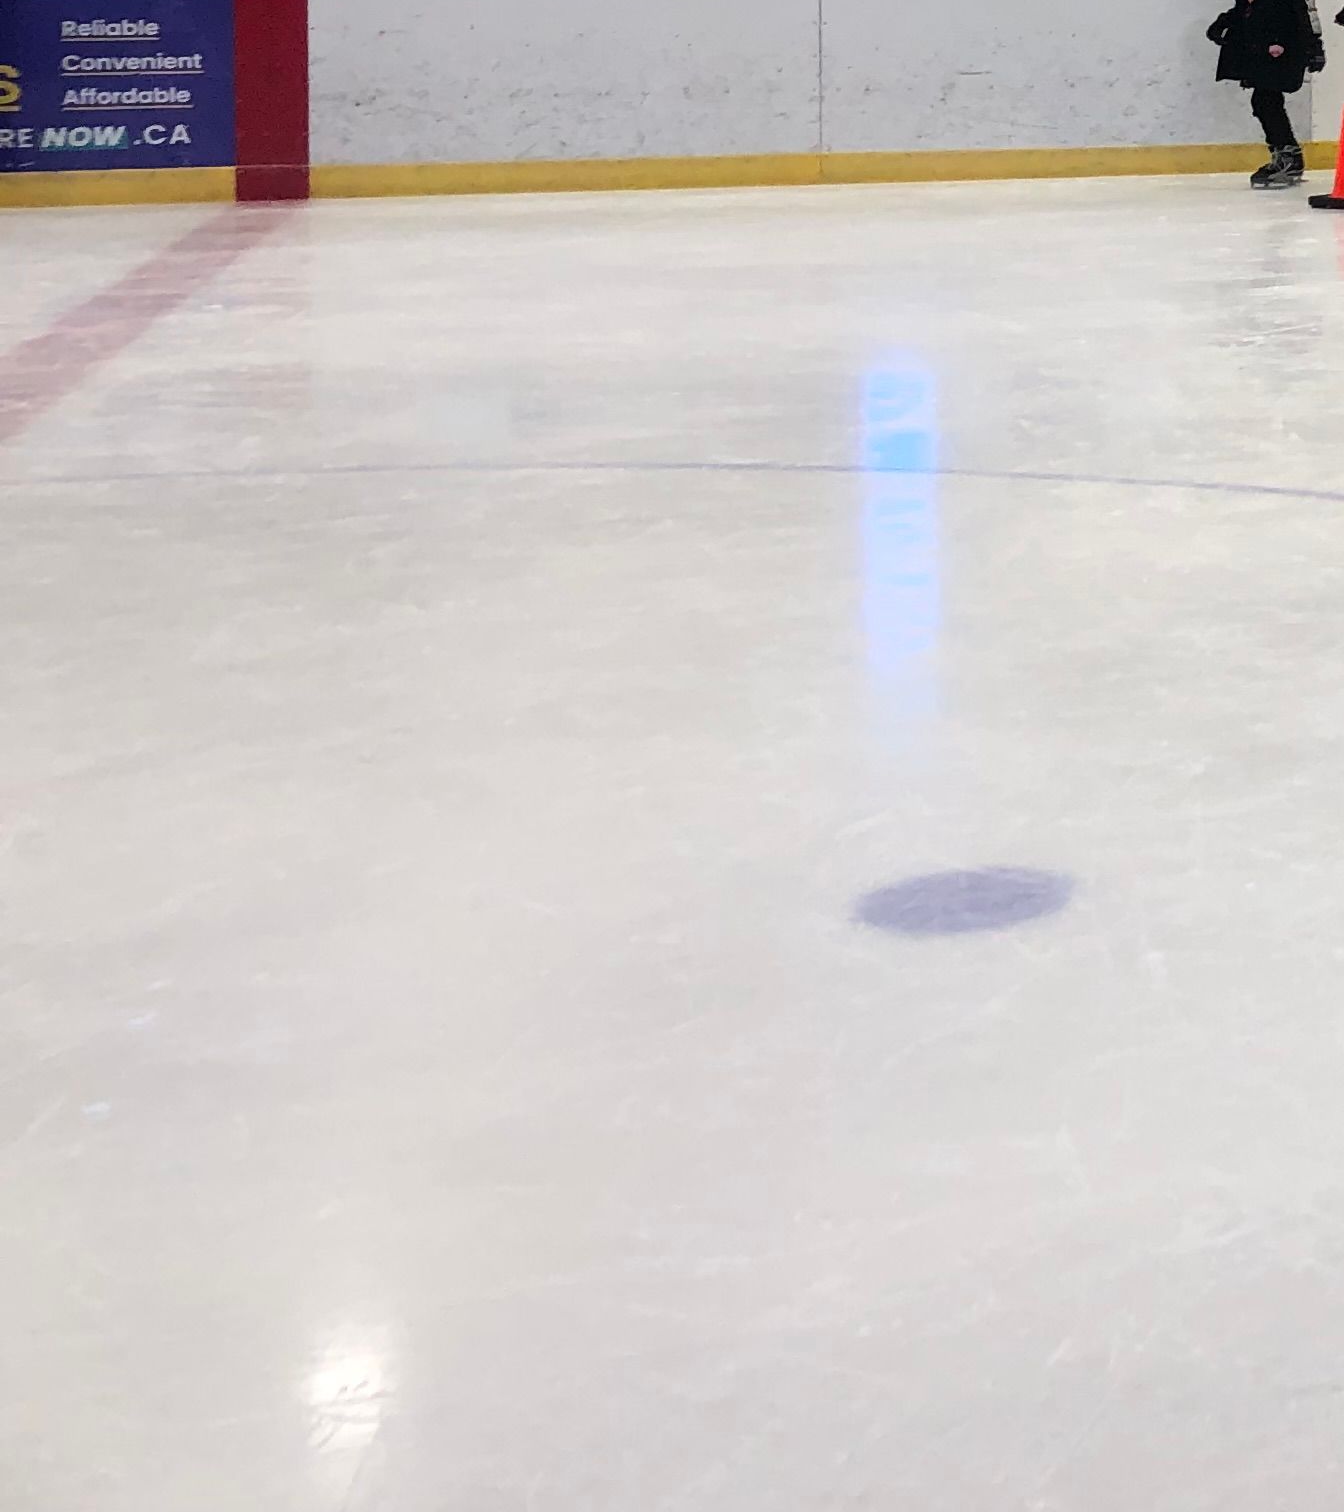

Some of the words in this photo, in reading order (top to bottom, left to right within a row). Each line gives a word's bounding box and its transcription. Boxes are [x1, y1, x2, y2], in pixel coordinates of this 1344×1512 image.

[61, 19, 160, 37] Reliable
[62, 52, 203, 71] Convenient
[63, 87, 191, 105] Affordable
[41, 125, 126, 148] NOW
